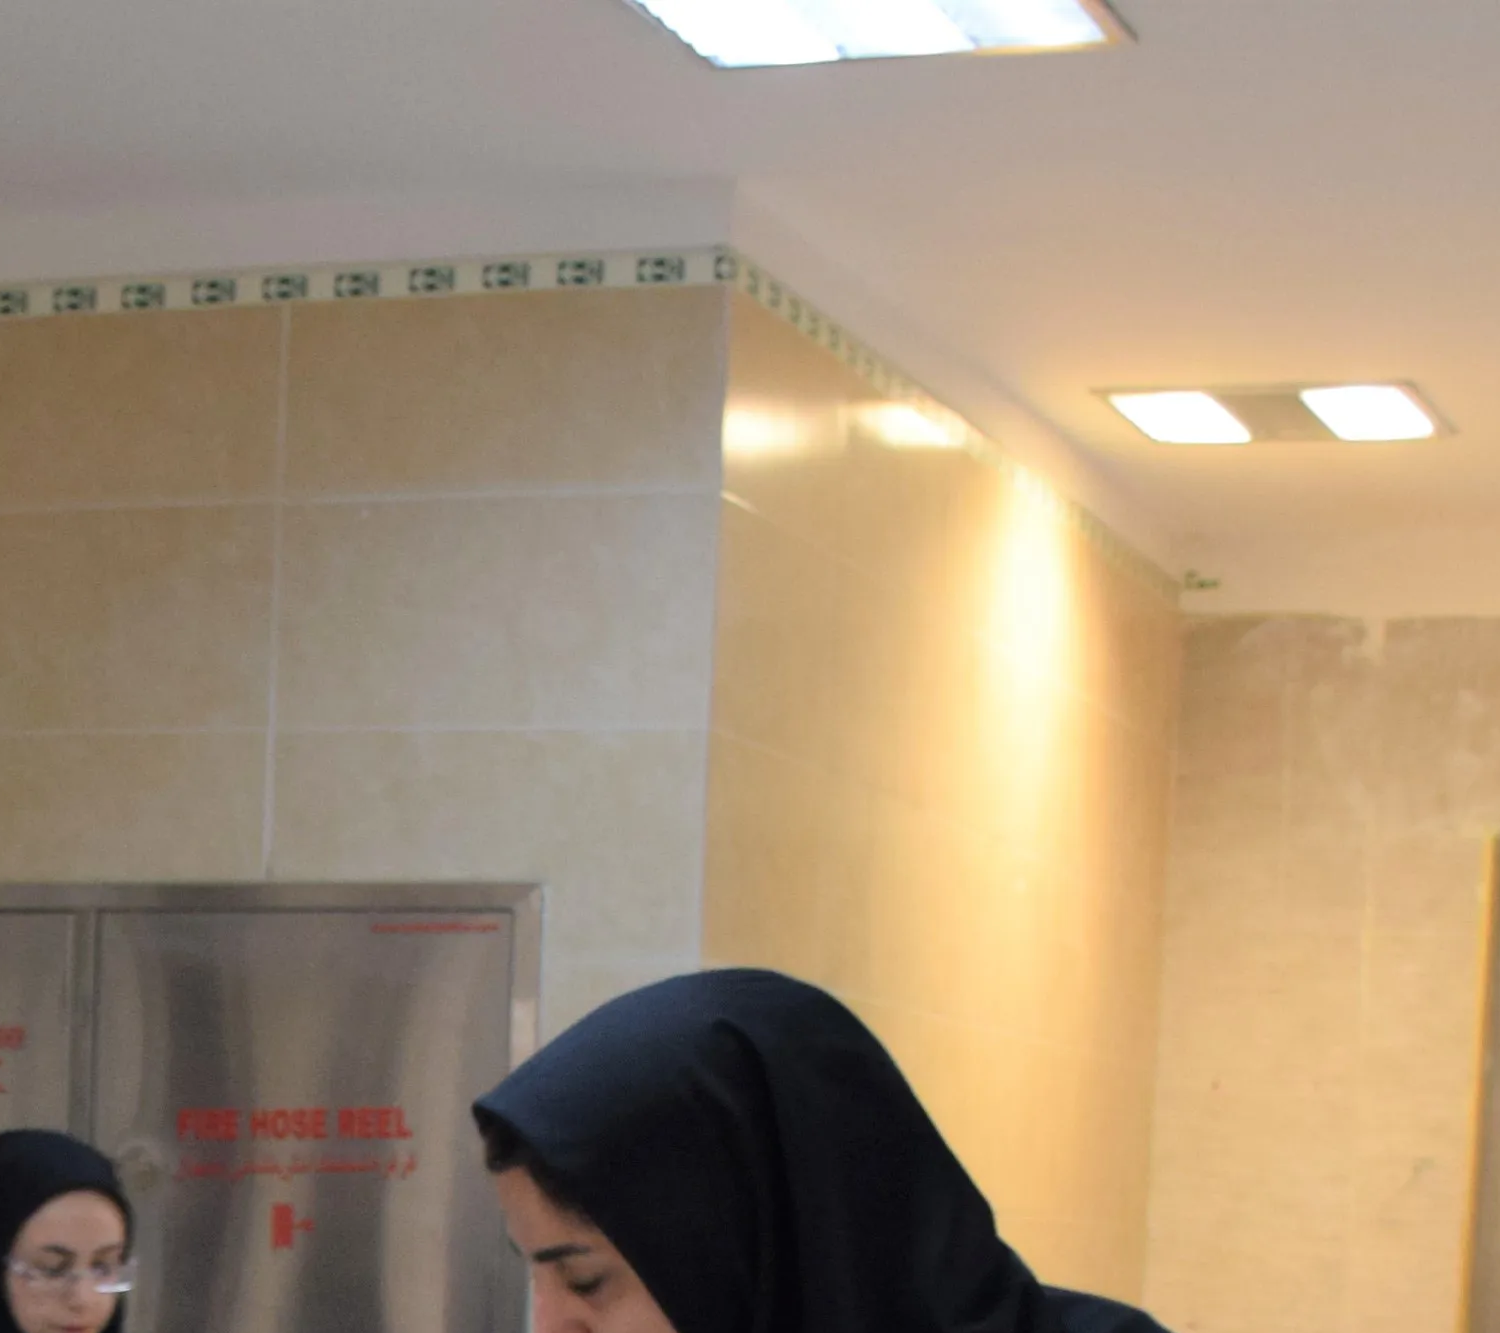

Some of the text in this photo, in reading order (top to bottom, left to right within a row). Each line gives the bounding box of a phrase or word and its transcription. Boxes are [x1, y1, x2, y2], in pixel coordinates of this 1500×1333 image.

[176, 1106, 413, 1141] FIRE HOSE REEL
